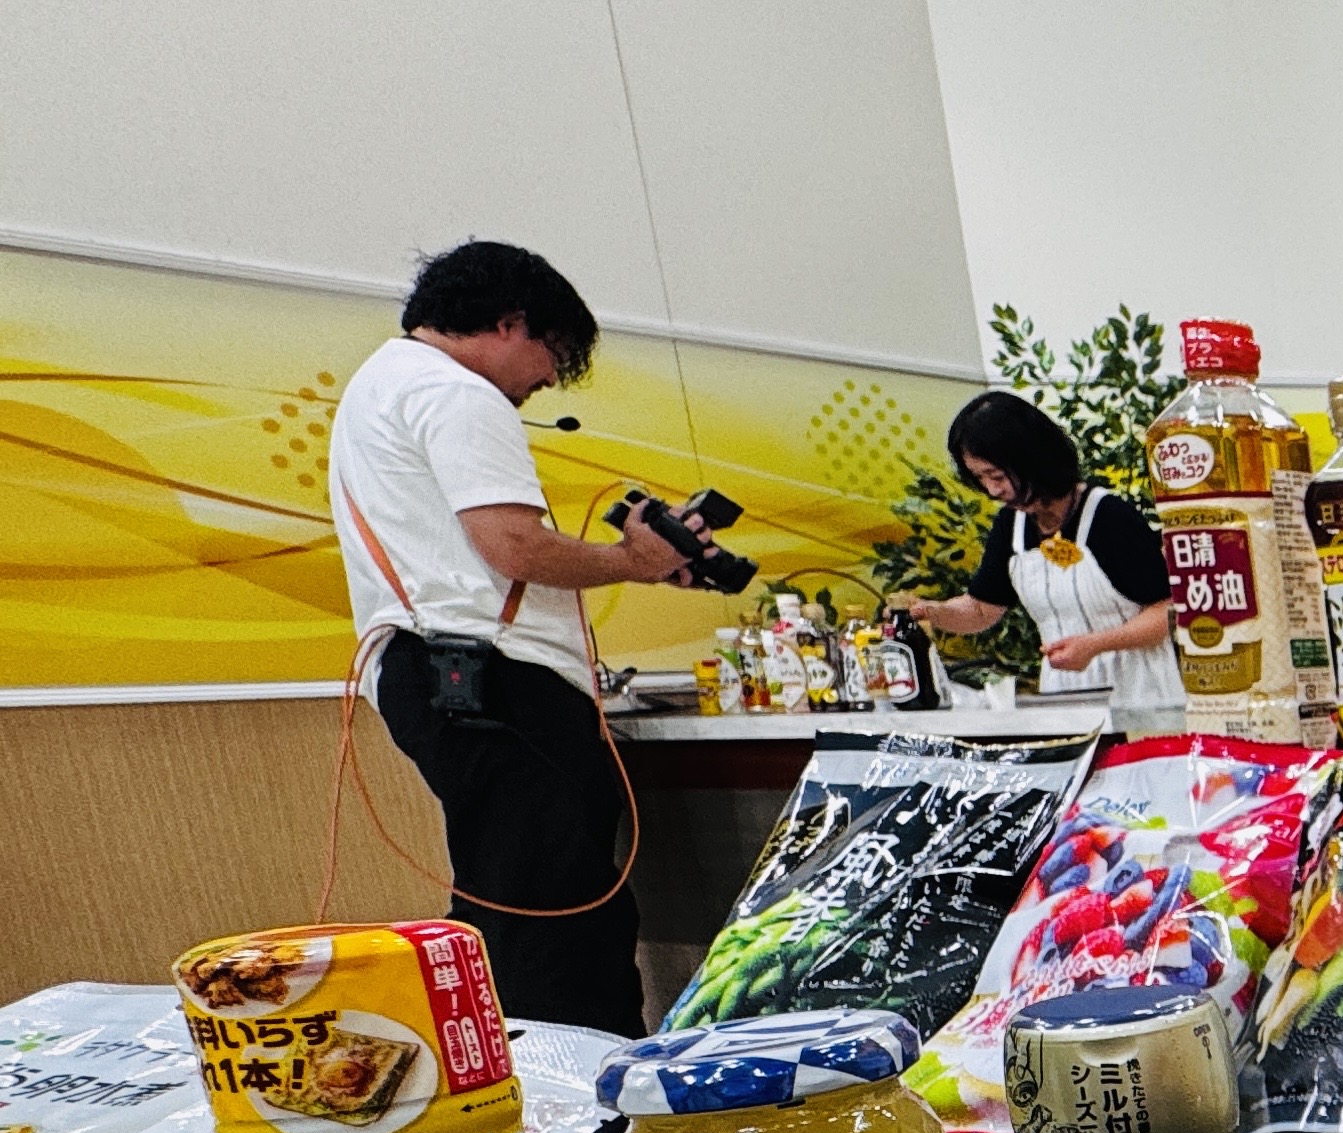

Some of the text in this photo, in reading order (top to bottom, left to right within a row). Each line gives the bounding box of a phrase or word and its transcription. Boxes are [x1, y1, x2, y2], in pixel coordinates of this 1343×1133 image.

[1171, 532, 1216, 568] 日清
[188, 1010, 336, 1050] 料いらず
